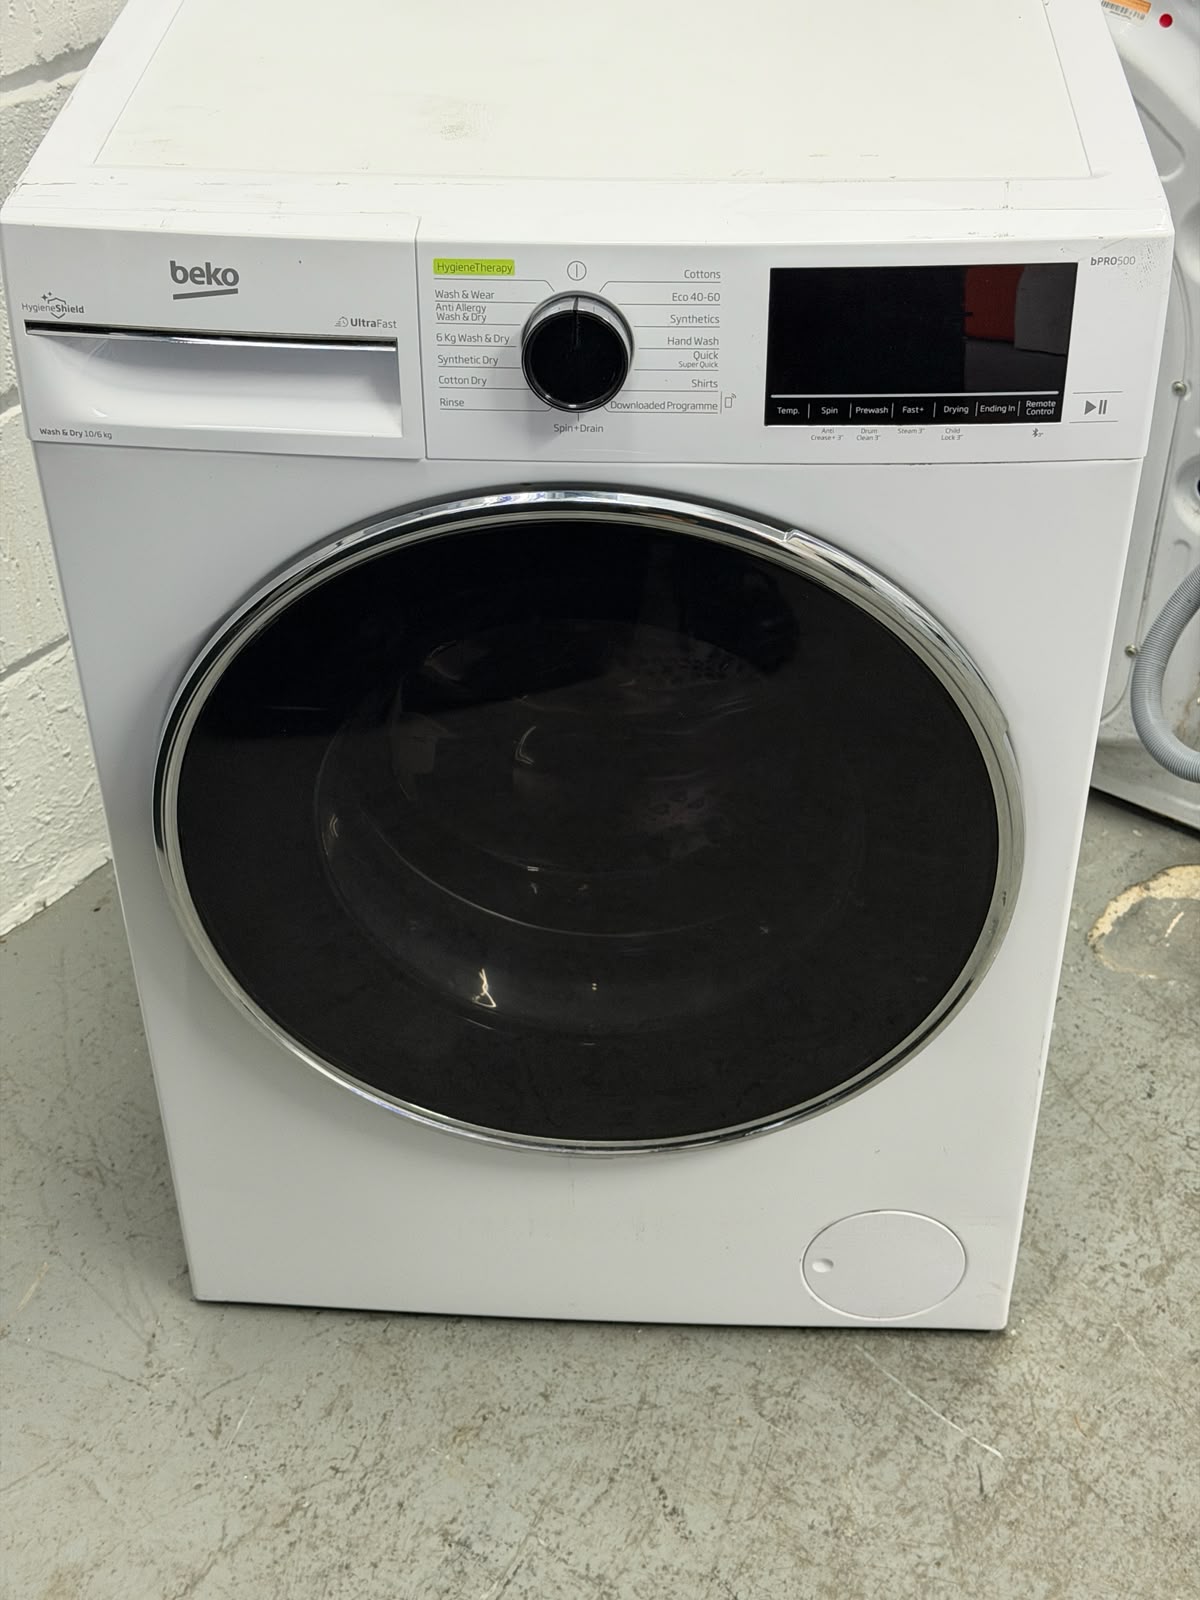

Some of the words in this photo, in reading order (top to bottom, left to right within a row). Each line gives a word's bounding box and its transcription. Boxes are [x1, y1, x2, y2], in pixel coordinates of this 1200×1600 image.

[1090, 256, 1136, 266] bPRO500
[169, 260, 240, 287] beko
[437, 262, 513, 275] HygieneTherapy
[684, 269, 721, 279] Cottons
[435, 289, 460, 299] Wash
[462, 290, 469, 299] &
[471, 290, 495, 299] Wear
[672, 292, 689, 302] Eco
[690, 292, 721, 302] 40-60
[21, 303, 85, 314] HygieneShield
[435, 303, 455, 312] Anti
[456, 303, 487, 314] Allergy
[436, 312, 461, 321] Wash
[462, 313, 469, 321] &
[471, 313, 487, 323] Dry
[670, 314, 720, 325] Synthetics
[350, 317, 398, 329] UltraFast
[436, 333, 442, 342] 6
[444, 333, 457, 344] Kg
[458, 333, 483, 343] Wash
[484, 334, 492, 343] &
[493, 334, 510, 345] Dry
[667, 336, 692, 346] Hand
[694, 337, 719, 346] Wash
[437, 354, 480, 366] Synthetic
[482, 355, 499, 367] Dry
[693, 351, 719, 361] Quick
[678, 361, 699, 369] Super
[700, 361, 719, 369] Quick
[438, 375, 469, 385] Cotton
[471, 376, 487, 387] Dry
[691, 379, 718, 388] Shirts
[440, 398, 465, 407] Rinse
[610, 401, 666, 410] Downloaded
[666, 402, 718, 412] Programme
[1026, 400, 1057, 408] Remote
[777, 406, 800, 416] Temp.
[821, 406, 839, 416] Spin
[855, 406, 889, 414] Prewash
[902, 405, 924, 414] Fast+
[943, 405, 970, 415] Drying
[980, 404, 1007, 414] Ending
[1008, 404, 1016, 412] In
[1026, 407, 1055, 416] Control
[40, 427, 61, 436] Wash
[69, 429, 83, 438] Dry
[84, 430, 102, 438] 10/6
[103, 431, 113, 440] kg
